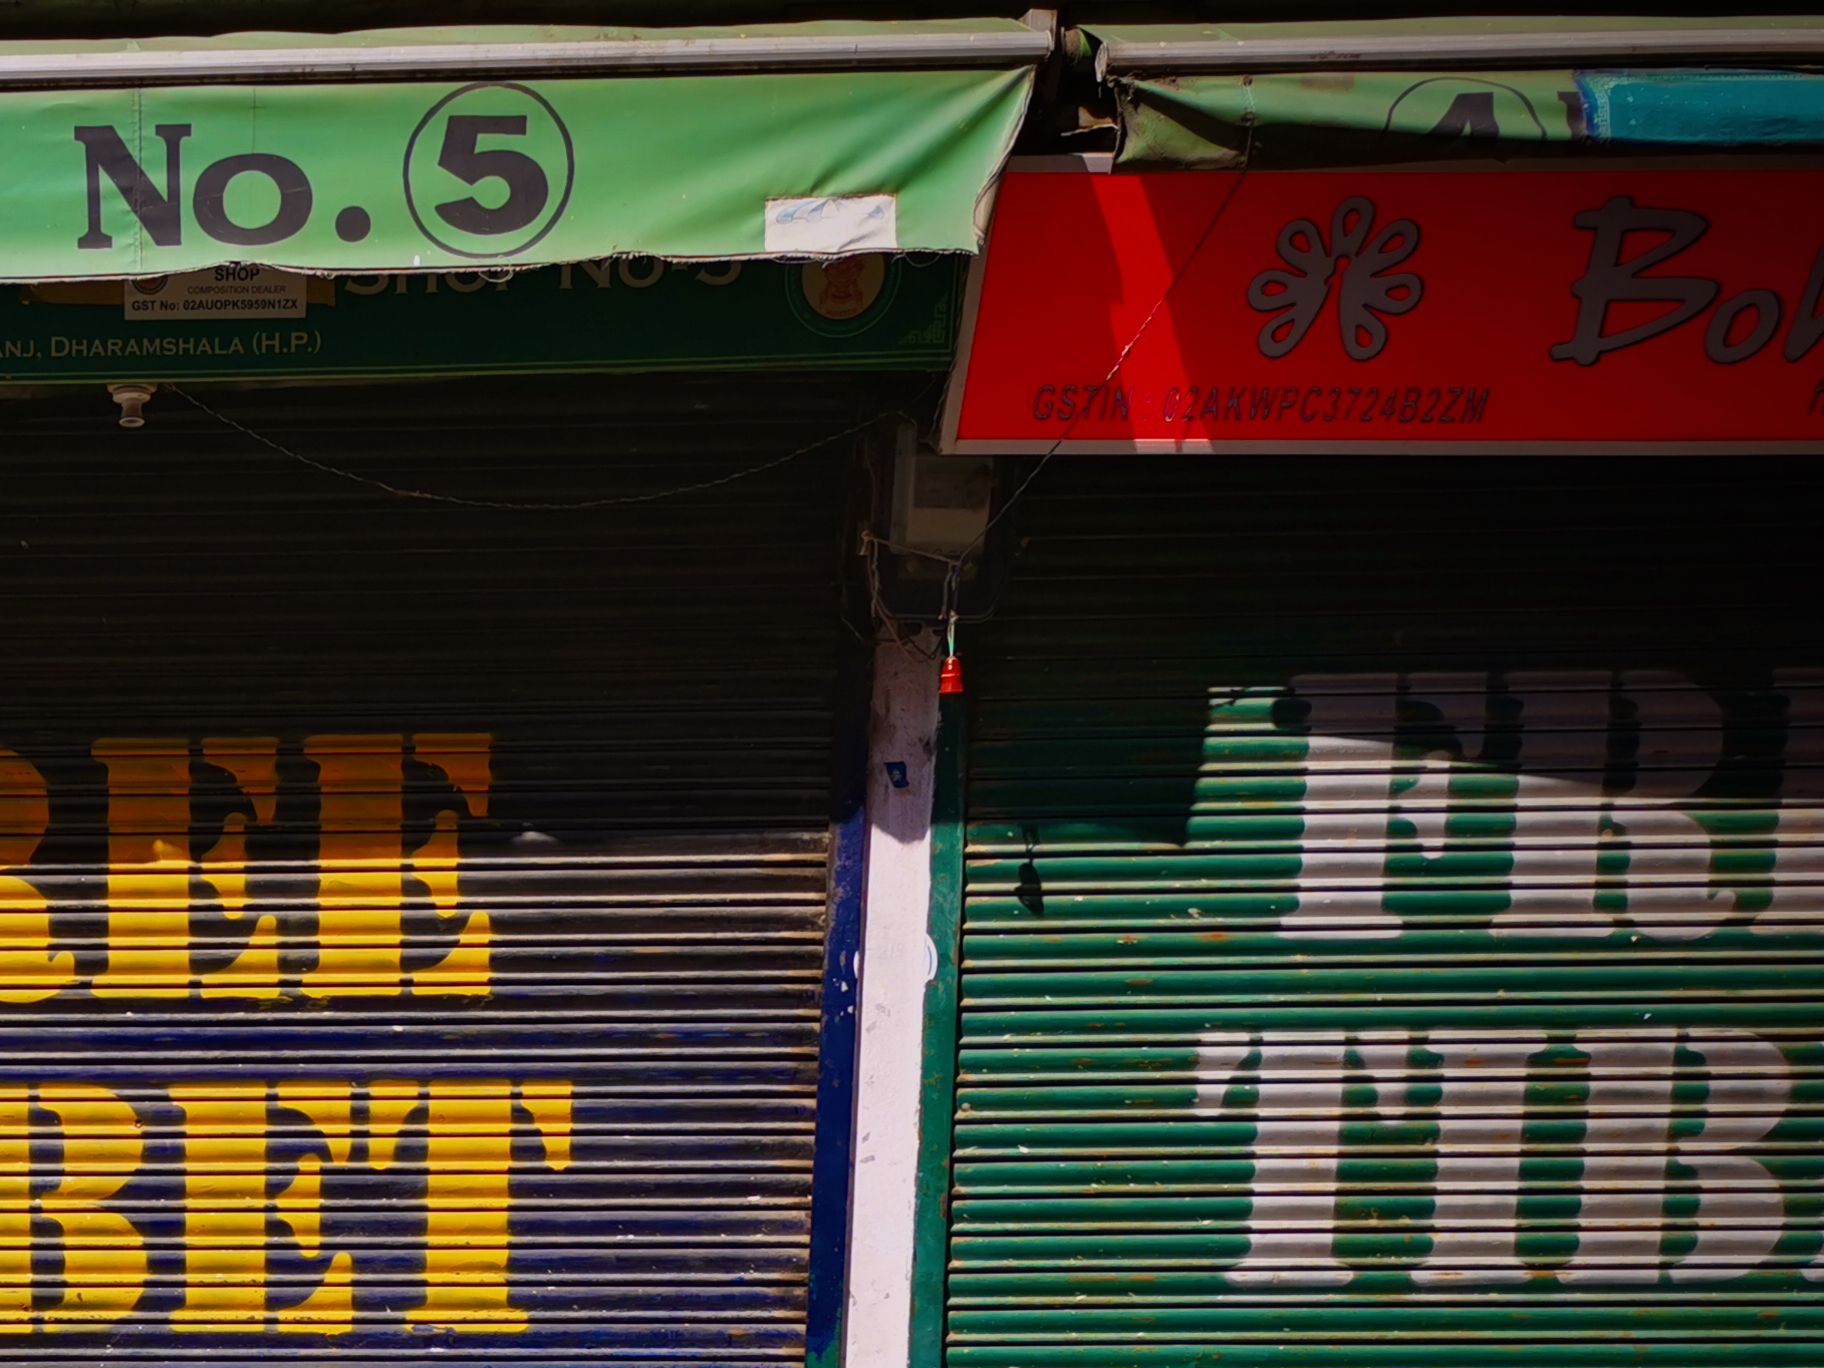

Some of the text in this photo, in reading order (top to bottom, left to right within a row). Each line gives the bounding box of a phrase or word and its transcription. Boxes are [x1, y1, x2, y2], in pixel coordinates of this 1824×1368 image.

[73, 122, 372, 251] No.
[433, 114, 550, 236] 5
[187, 284, 287, 295] COMPOSITION DEALER
[214, 267, 260, 282] SHOP
[131, 300, 155, 312] GST
[50, 335, 245, 359] DHARAMSHALA
[252, 329, 323, 356] (H.P.)
[1276, 666, 1824, 942] FR
[1193, 1026, 1824, 1286] TIB
